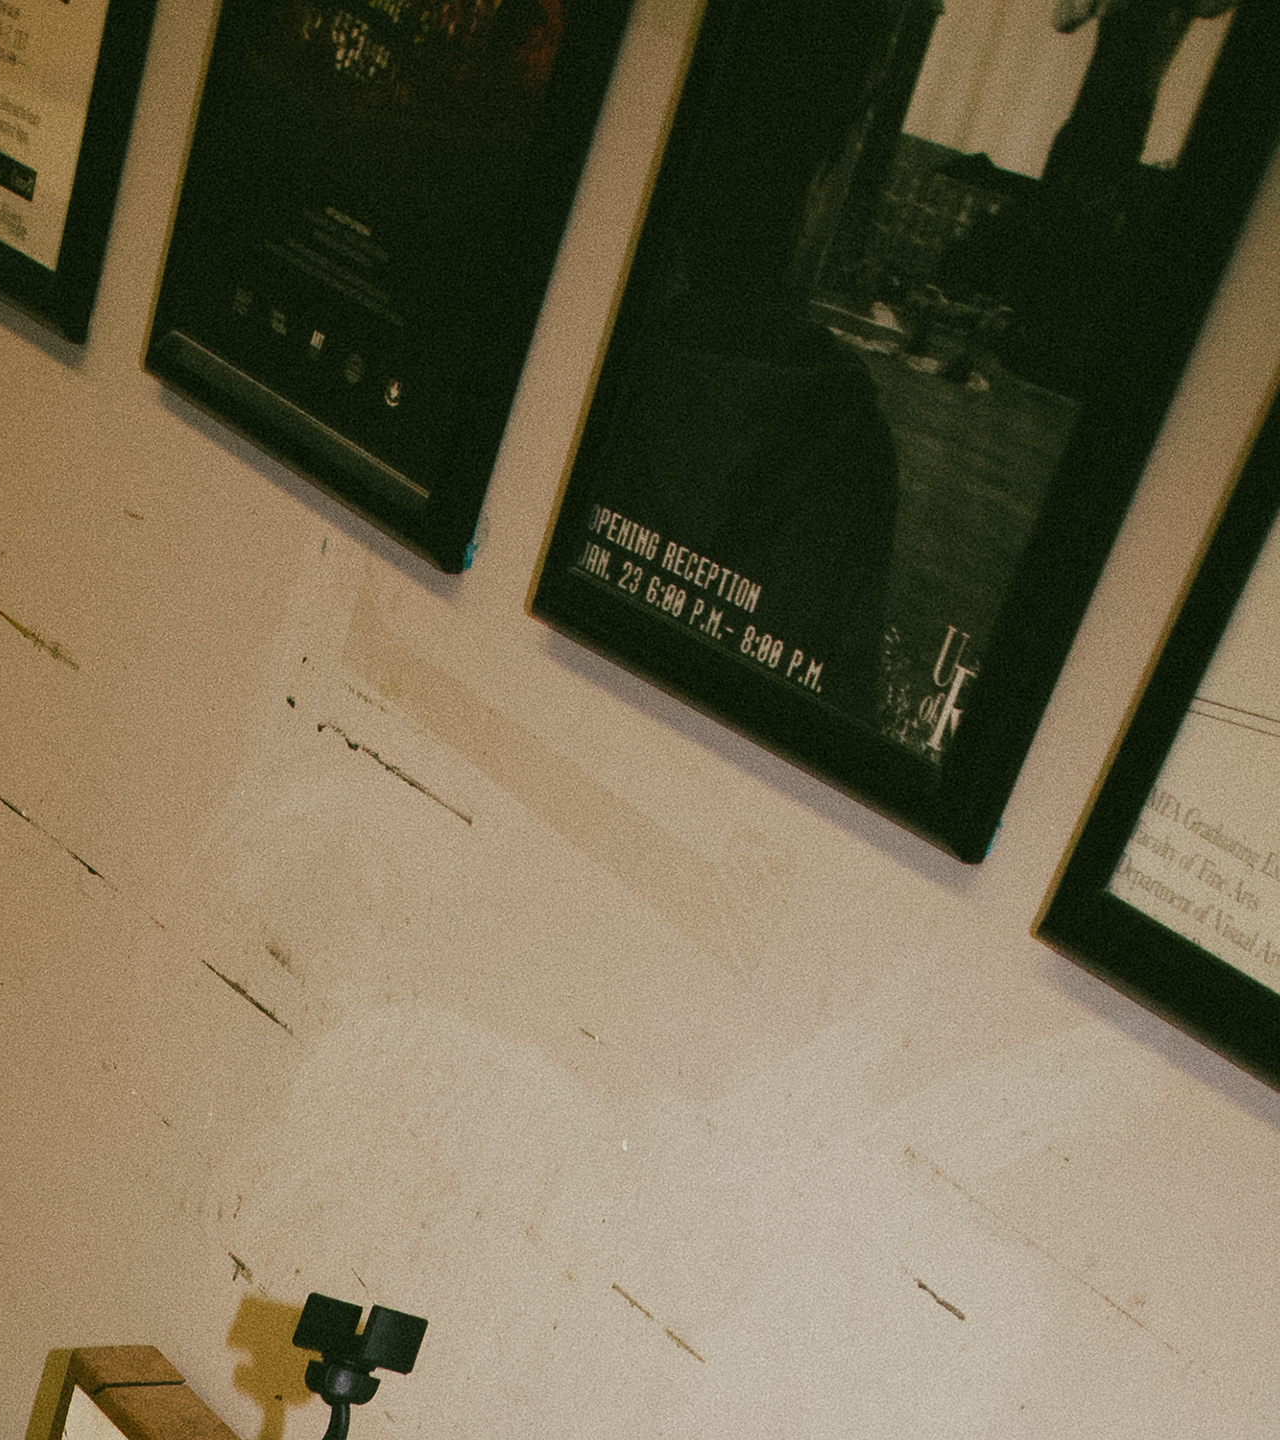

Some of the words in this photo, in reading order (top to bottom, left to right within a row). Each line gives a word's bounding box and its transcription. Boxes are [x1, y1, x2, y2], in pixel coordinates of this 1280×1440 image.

[575, 540, 619, 581] JAN.
[614, 560, 646, 594] 23
[642, 575, 689, 617] 6:00
[736, 624, 787, 669] 8:00
[783, 649, 832, 693] P.M.
[658, 540, 765, 613] RECEPTION
